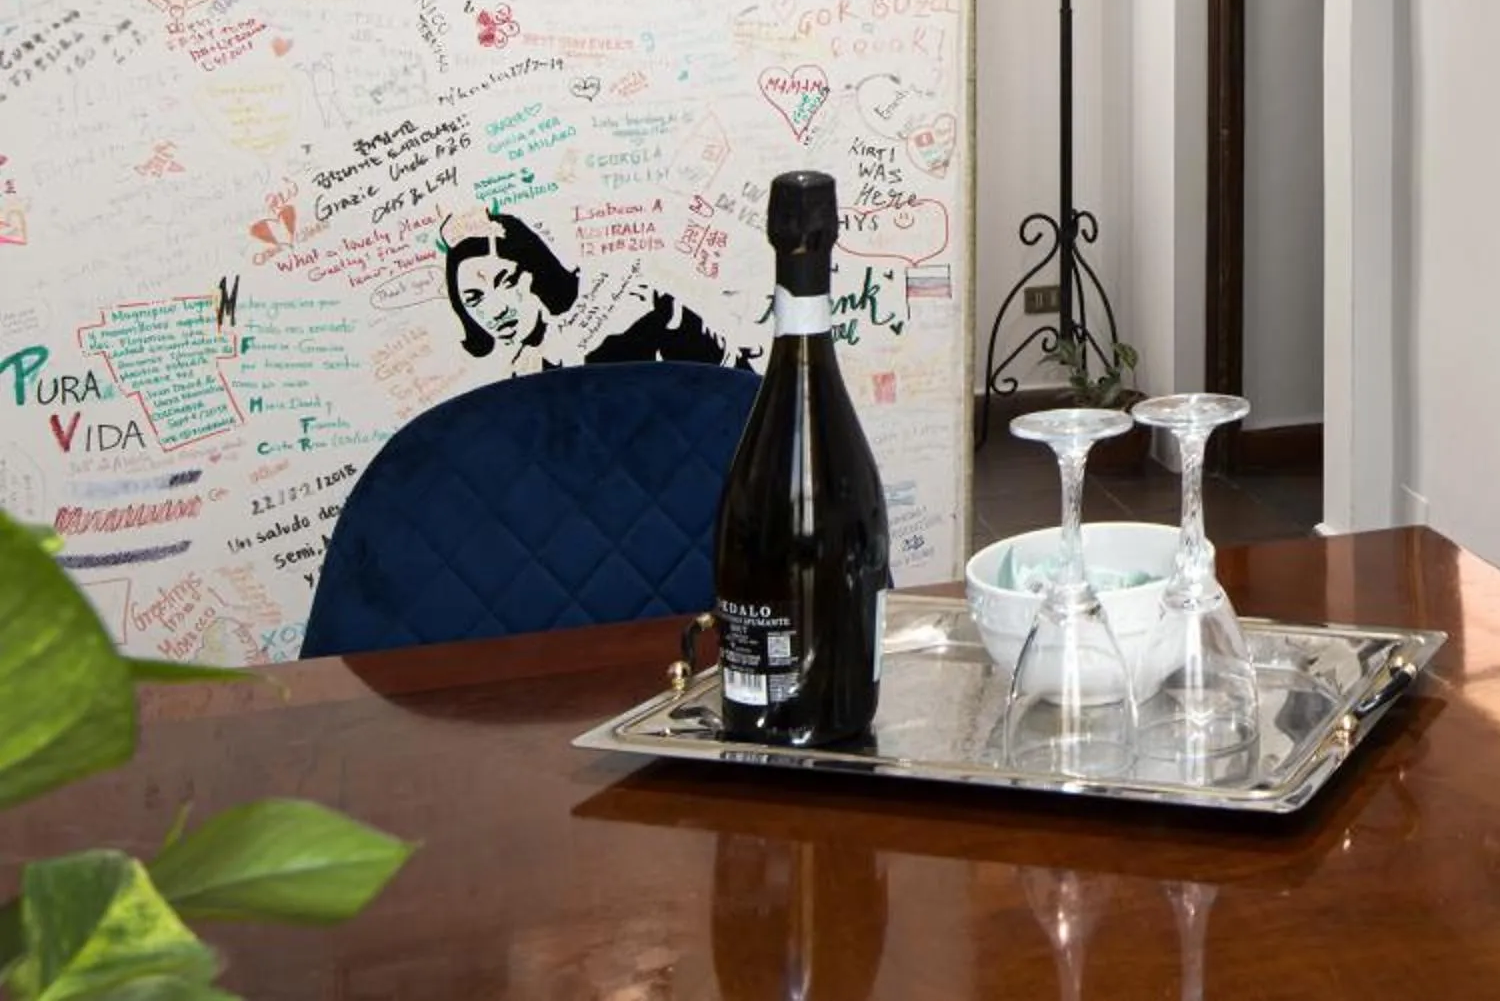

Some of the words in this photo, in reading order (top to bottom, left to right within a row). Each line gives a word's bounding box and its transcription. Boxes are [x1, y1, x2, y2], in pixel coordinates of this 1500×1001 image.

[838, 214, 880, 232] HYS
[0, 345, 102, 407] PURA
[49, 411, 148, 454] VIDA
[255, 514, 312, 545] saludo
